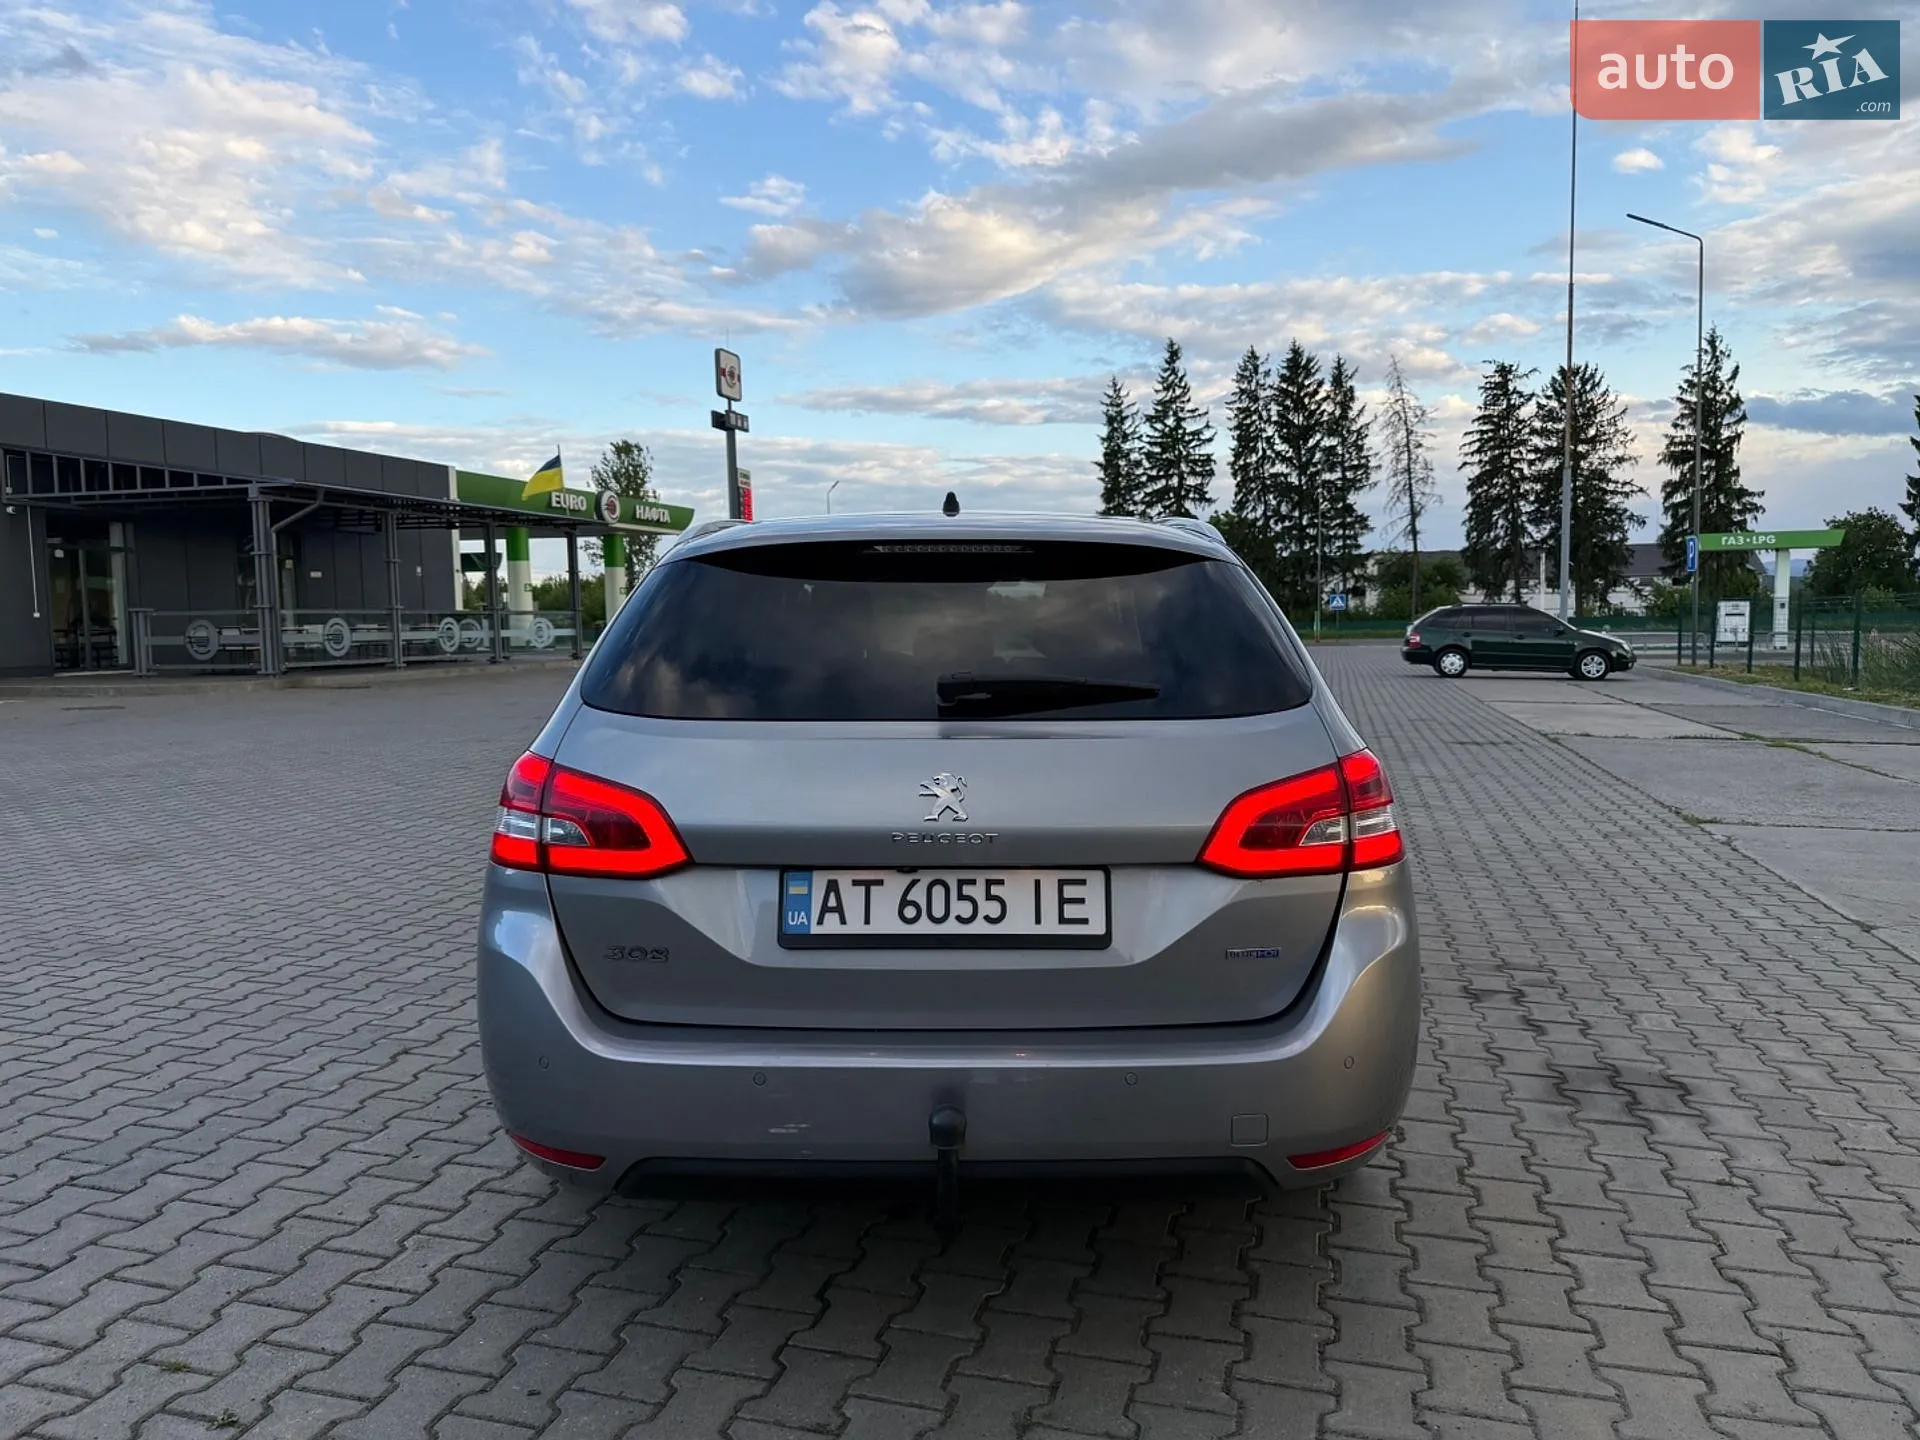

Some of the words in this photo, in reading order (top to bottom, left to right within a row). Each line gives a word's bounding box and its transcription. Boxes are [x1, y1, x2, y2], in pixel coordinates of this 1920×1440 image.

[551, 492, 587, 511] EURO
[635, 504, 671, 523] НАФТА
[1721, 536, 1744, 546] ГАЗ
[1752, 535, 1776, 545] LPG
[892, 832, 1000, 844] PEUGEOT
[816, 879, 884, 925] AT
[897, 878, 1007, 925] 6055
[1034, 879, 1090, 925] IE
[787, 911, 808, 926] UA
[603, 945, 670, 962] 308
